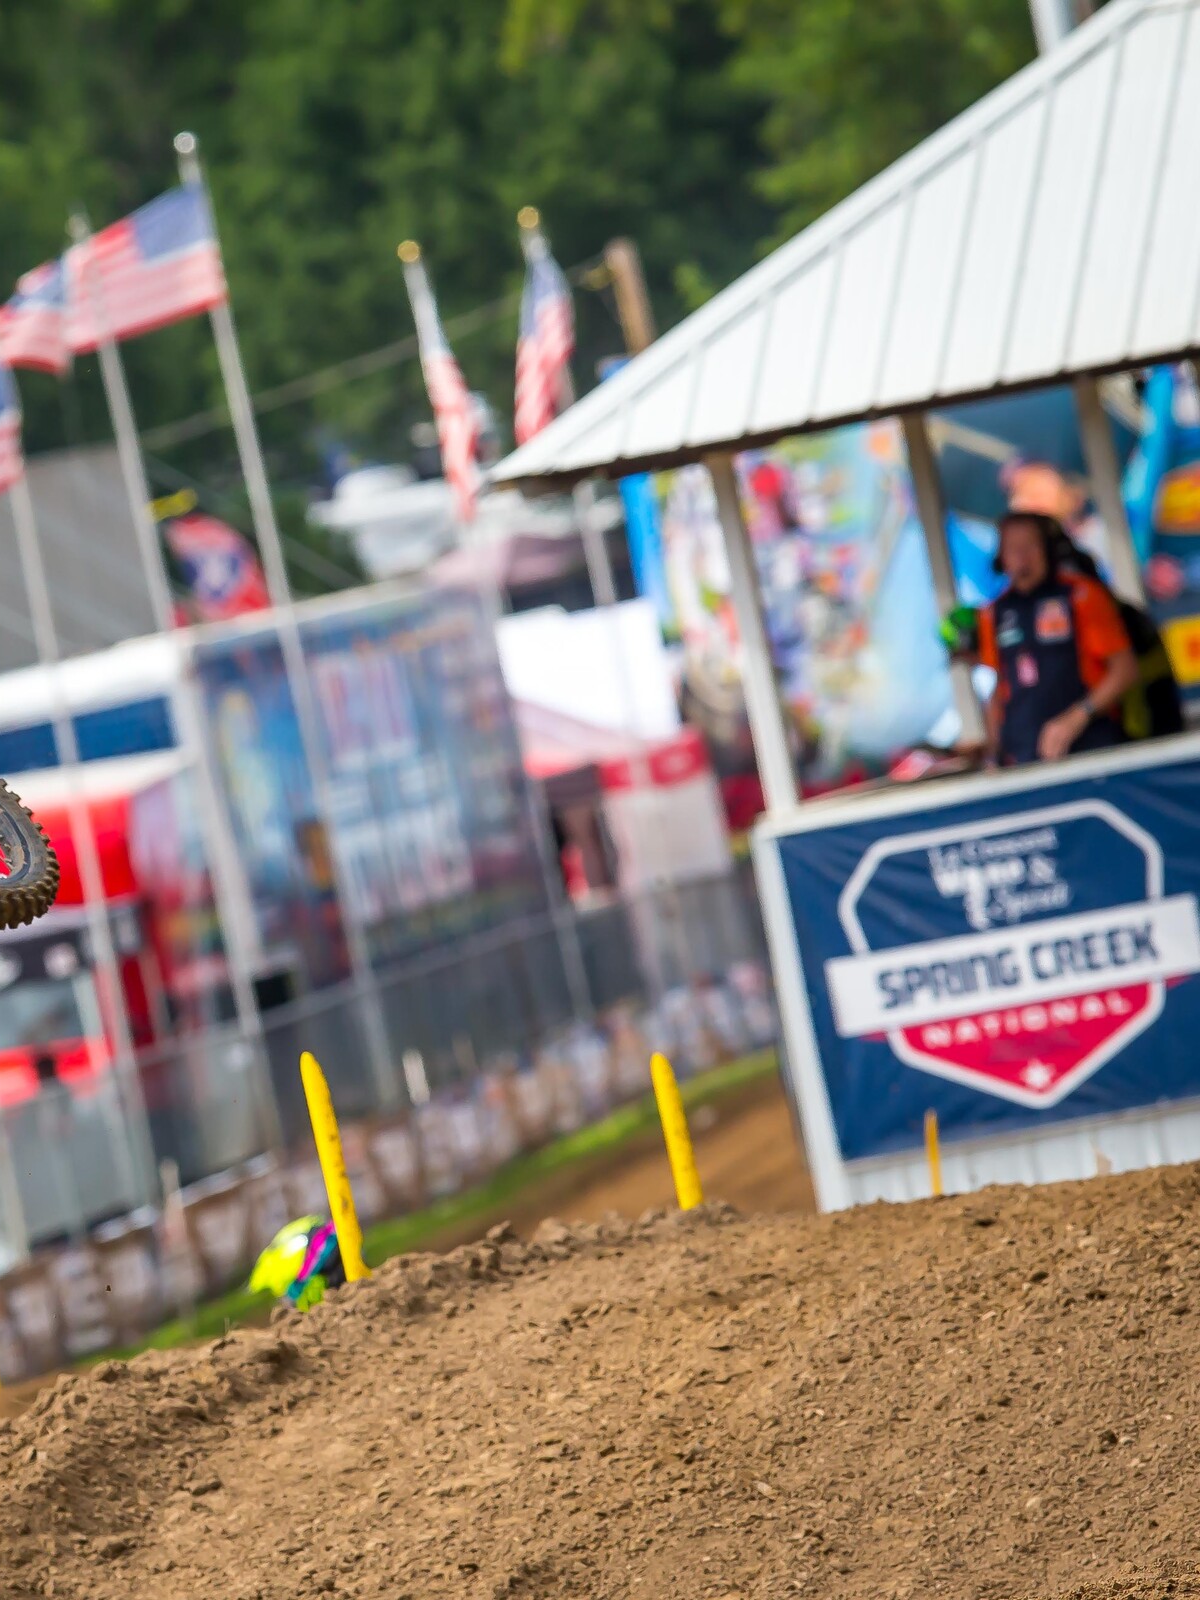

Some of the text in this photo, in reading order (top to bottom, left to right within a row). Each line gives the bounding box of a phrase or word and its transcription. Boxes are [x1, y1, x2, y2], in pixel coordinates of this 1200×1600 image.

[877, 919, 1159, 1010] SPRING CREEK
[921, 990, 1132, 1050] NATIONAL
